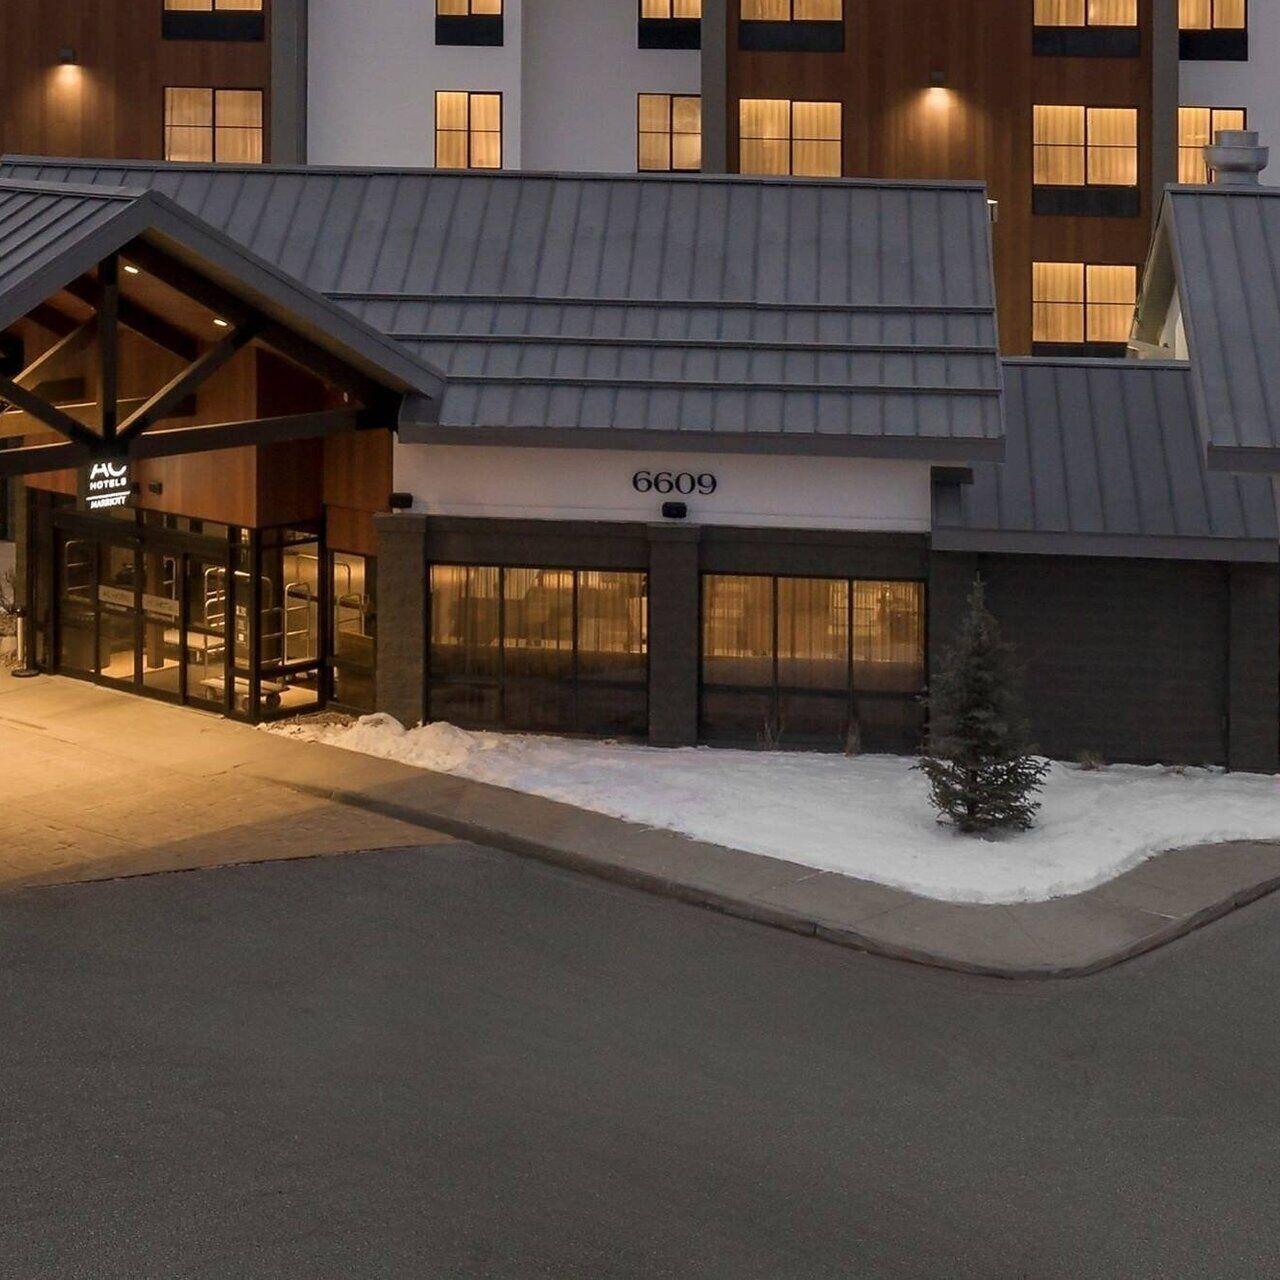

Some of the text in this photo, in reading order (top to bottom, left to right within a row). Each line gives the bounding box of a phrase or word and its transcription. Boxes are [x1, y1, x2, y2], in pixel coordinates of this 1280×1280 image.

[90, 477, 127, 491] HOTELS
[632, 470, 717, 495] 6609
[90, 496, 126, 509] MARRIOTT
